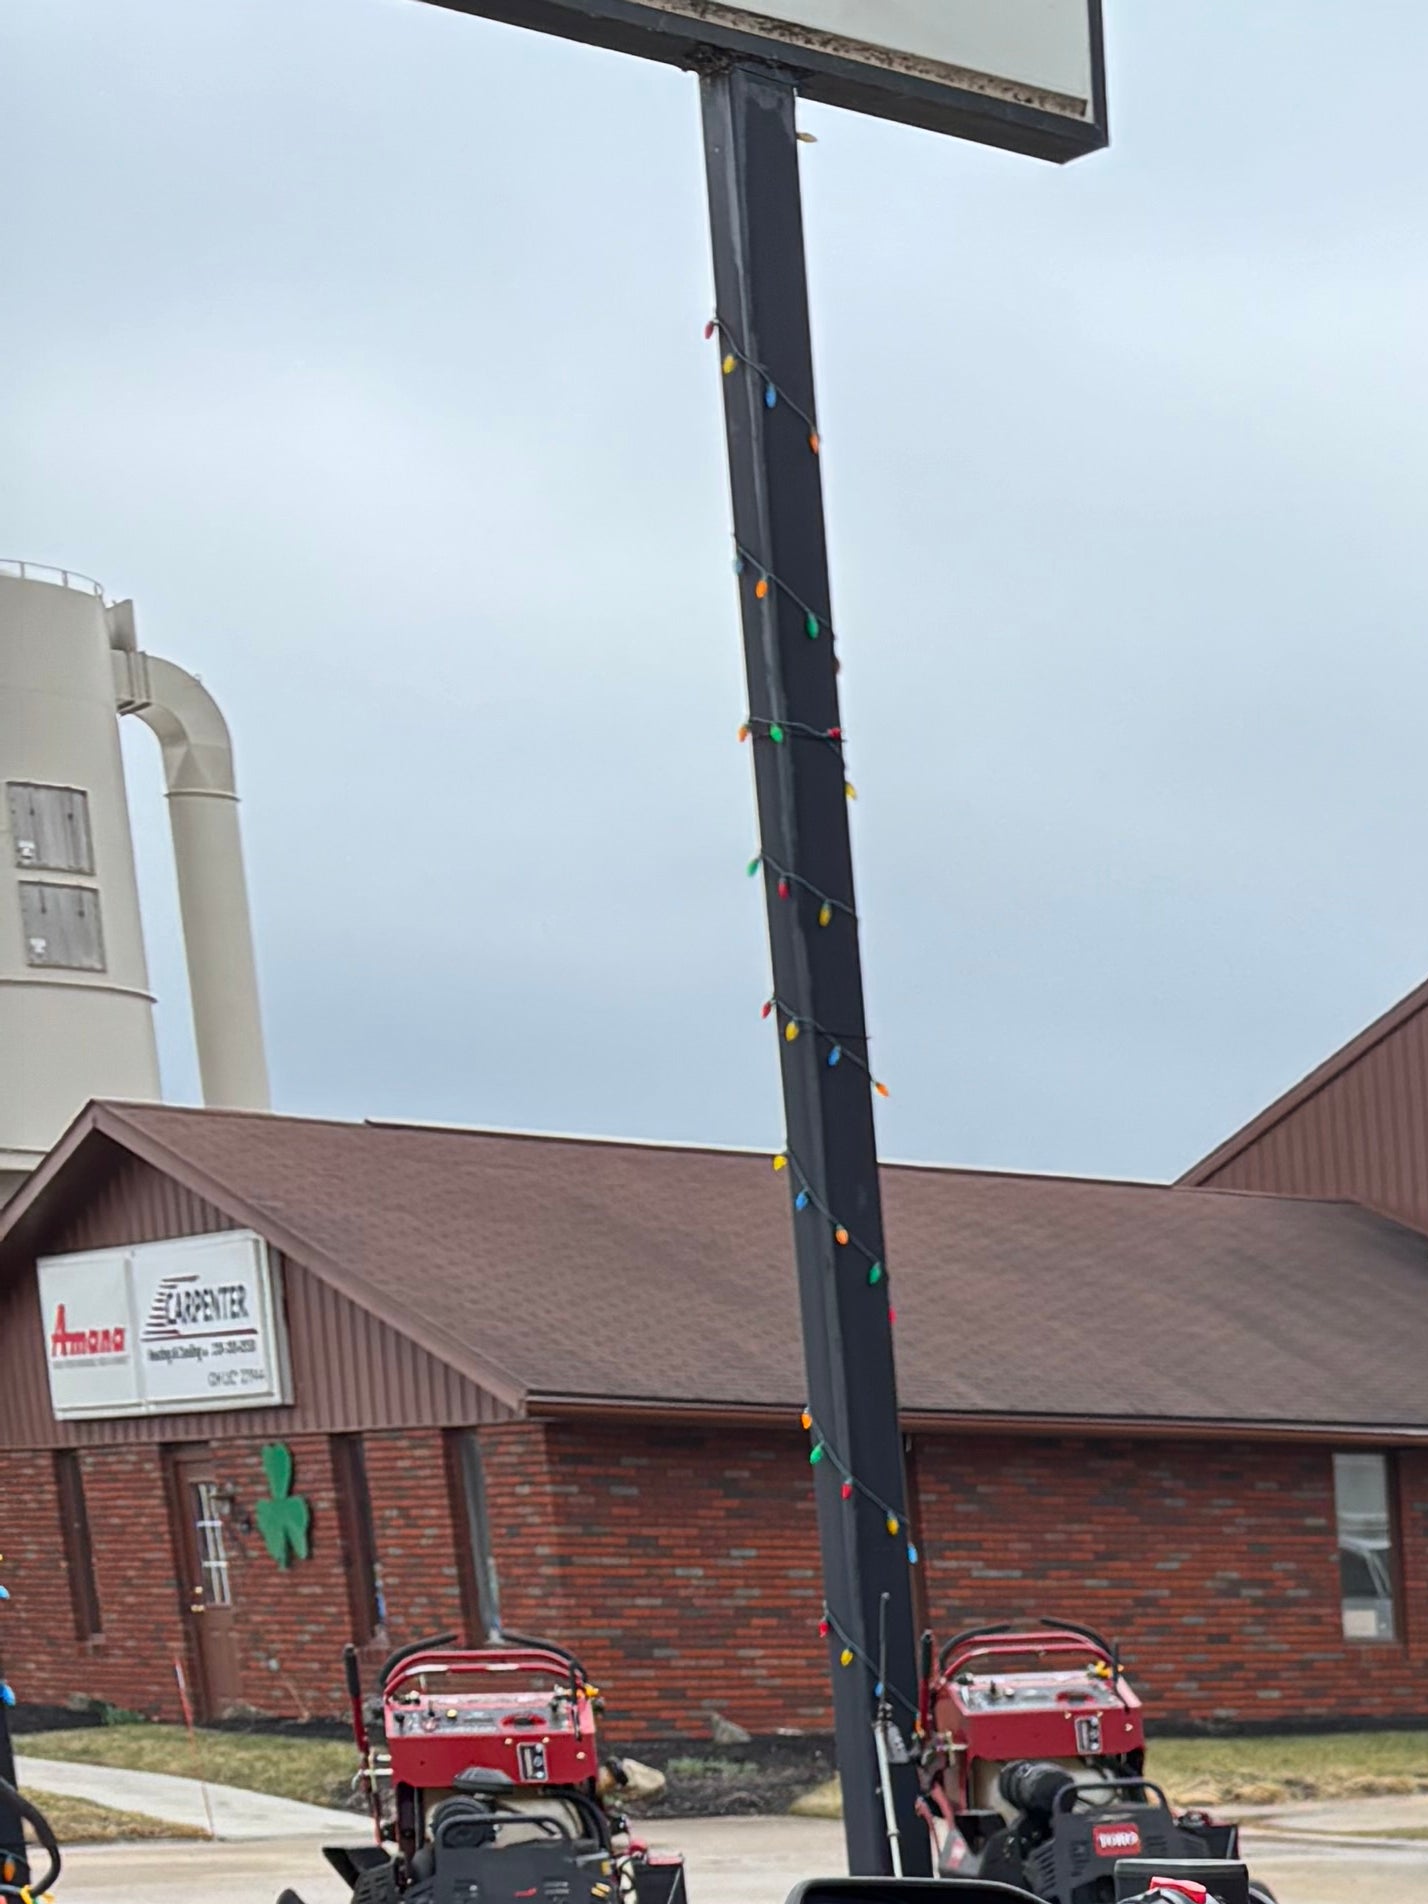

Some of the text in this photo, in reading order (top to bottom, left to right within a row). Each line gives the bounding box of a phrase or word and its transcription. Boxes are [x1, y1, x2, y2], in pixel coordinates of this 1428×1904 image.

[166, 1284, 249, 1325] CARPENTER
[52, 1304, 126, 1357] Amana
[1099, 1831, 1139, 1849] TORO
